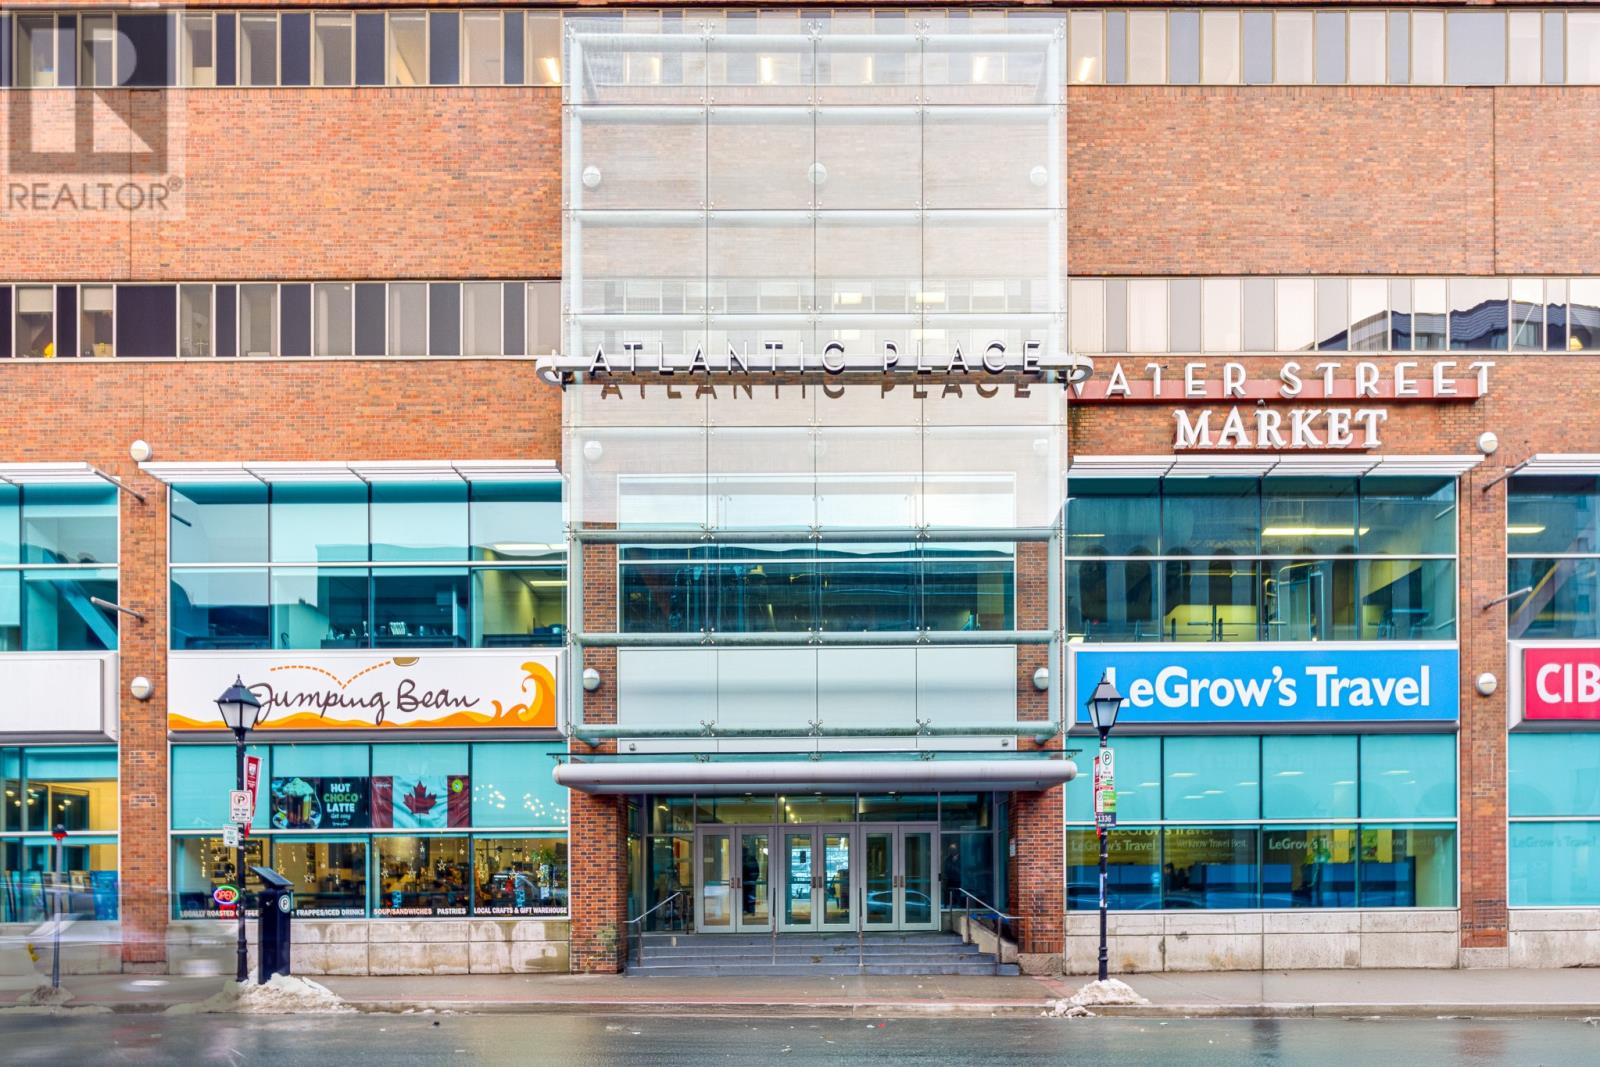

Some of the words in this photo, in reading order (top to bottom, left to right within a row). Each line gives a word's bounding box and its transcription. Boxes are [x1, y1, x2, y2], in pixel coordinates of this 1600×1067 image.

[589, 340, 846, 376] ATLANTIC
[881, 340, 1042, 376] PLACE
[1280, 361, 1496, 398] STREET
[1173, 406, 1387, 449] MARKET
[1306, 665, 1430, 707] Travel
[247, 682, 391, 726] Jumping
[397, 678, 480, 713] Bean
[323, 793, 359, 803] CHOCO
[326, 802, 356, 813] LATTE
[216, 889, 236, 901] OPEN
[341, 908, 365, 916] DRINKS
[437, 907, 467, 915] PASTRIES
